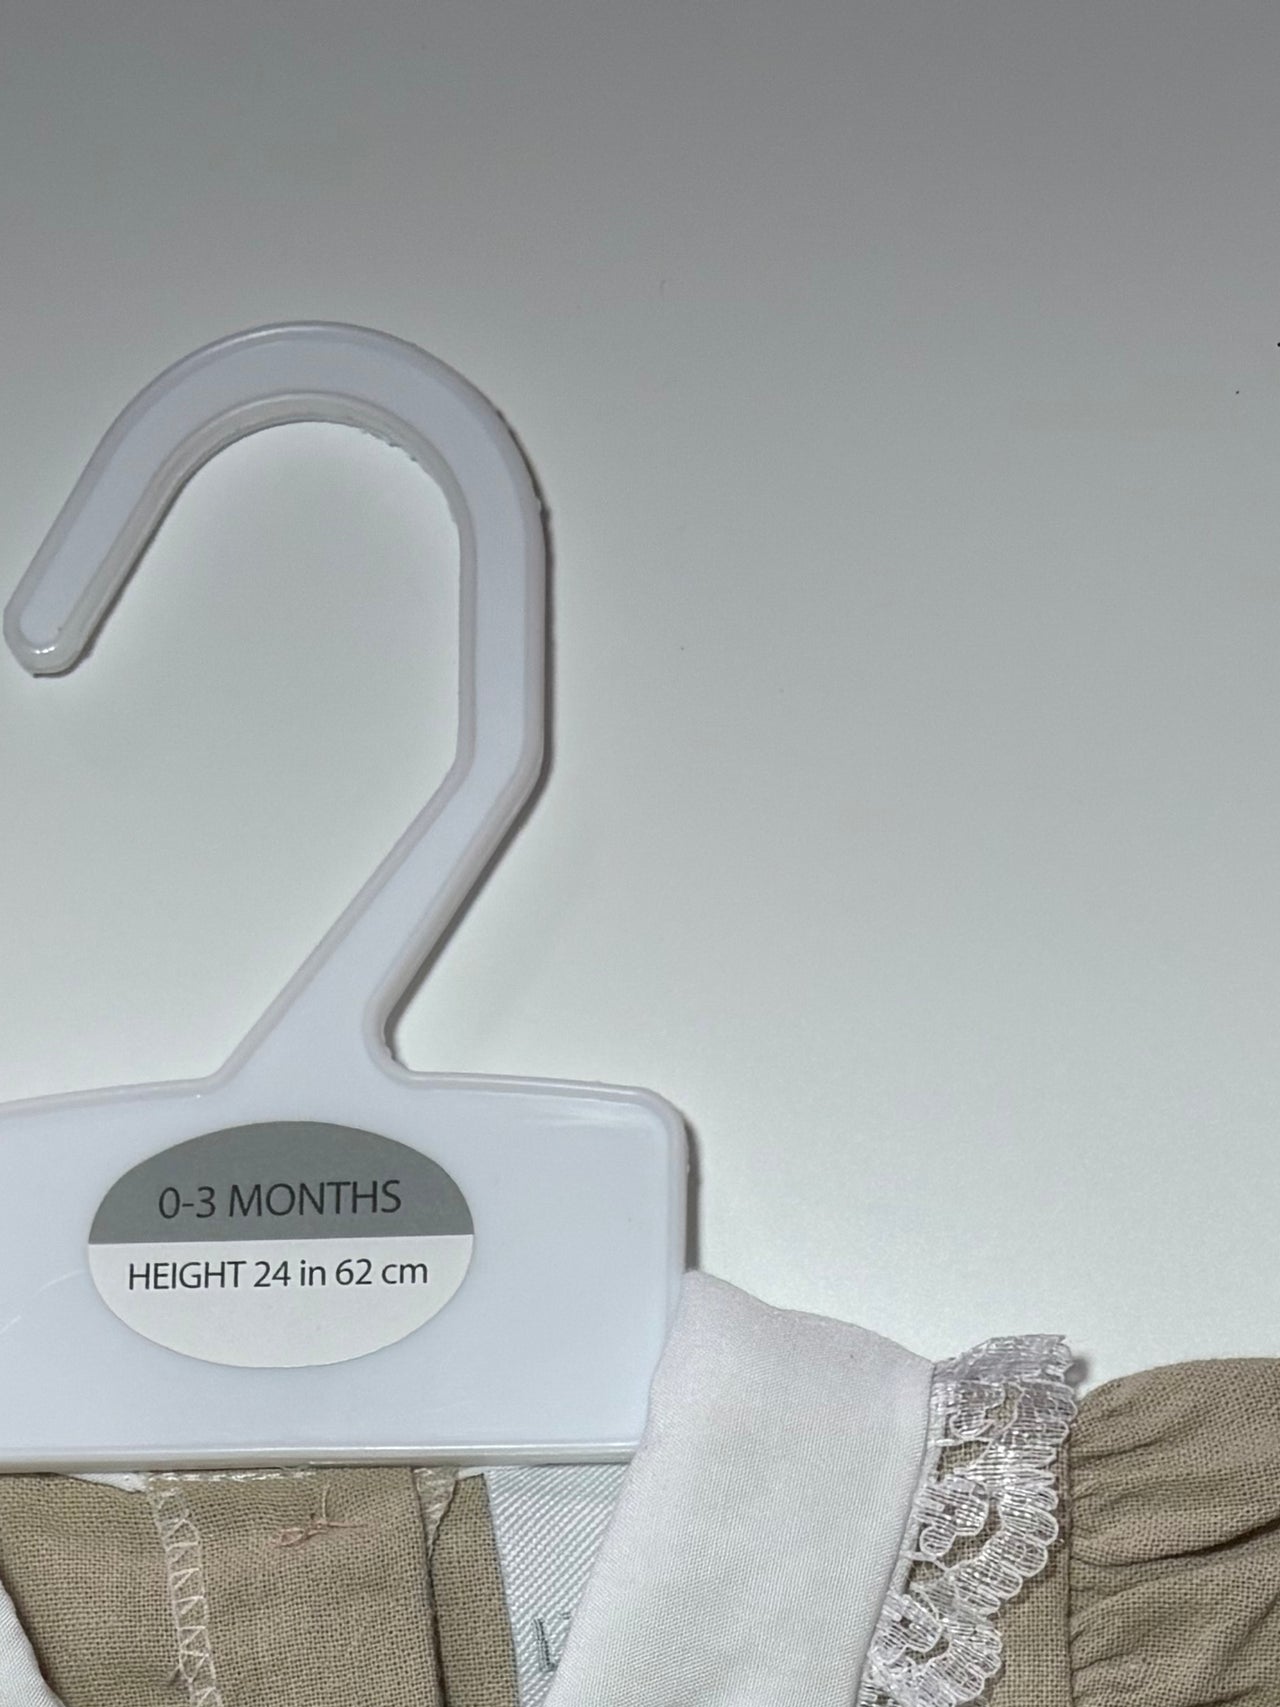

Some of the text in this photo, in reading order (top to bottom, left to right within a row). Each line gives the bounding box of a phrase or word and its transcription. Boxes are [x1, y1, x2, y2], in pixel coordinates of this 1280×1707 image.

[158, 1179, 402, 1220] 0-3 MONTHS
[128, 1257, 429, 1291] HEIGHT 24 in 62 cm
